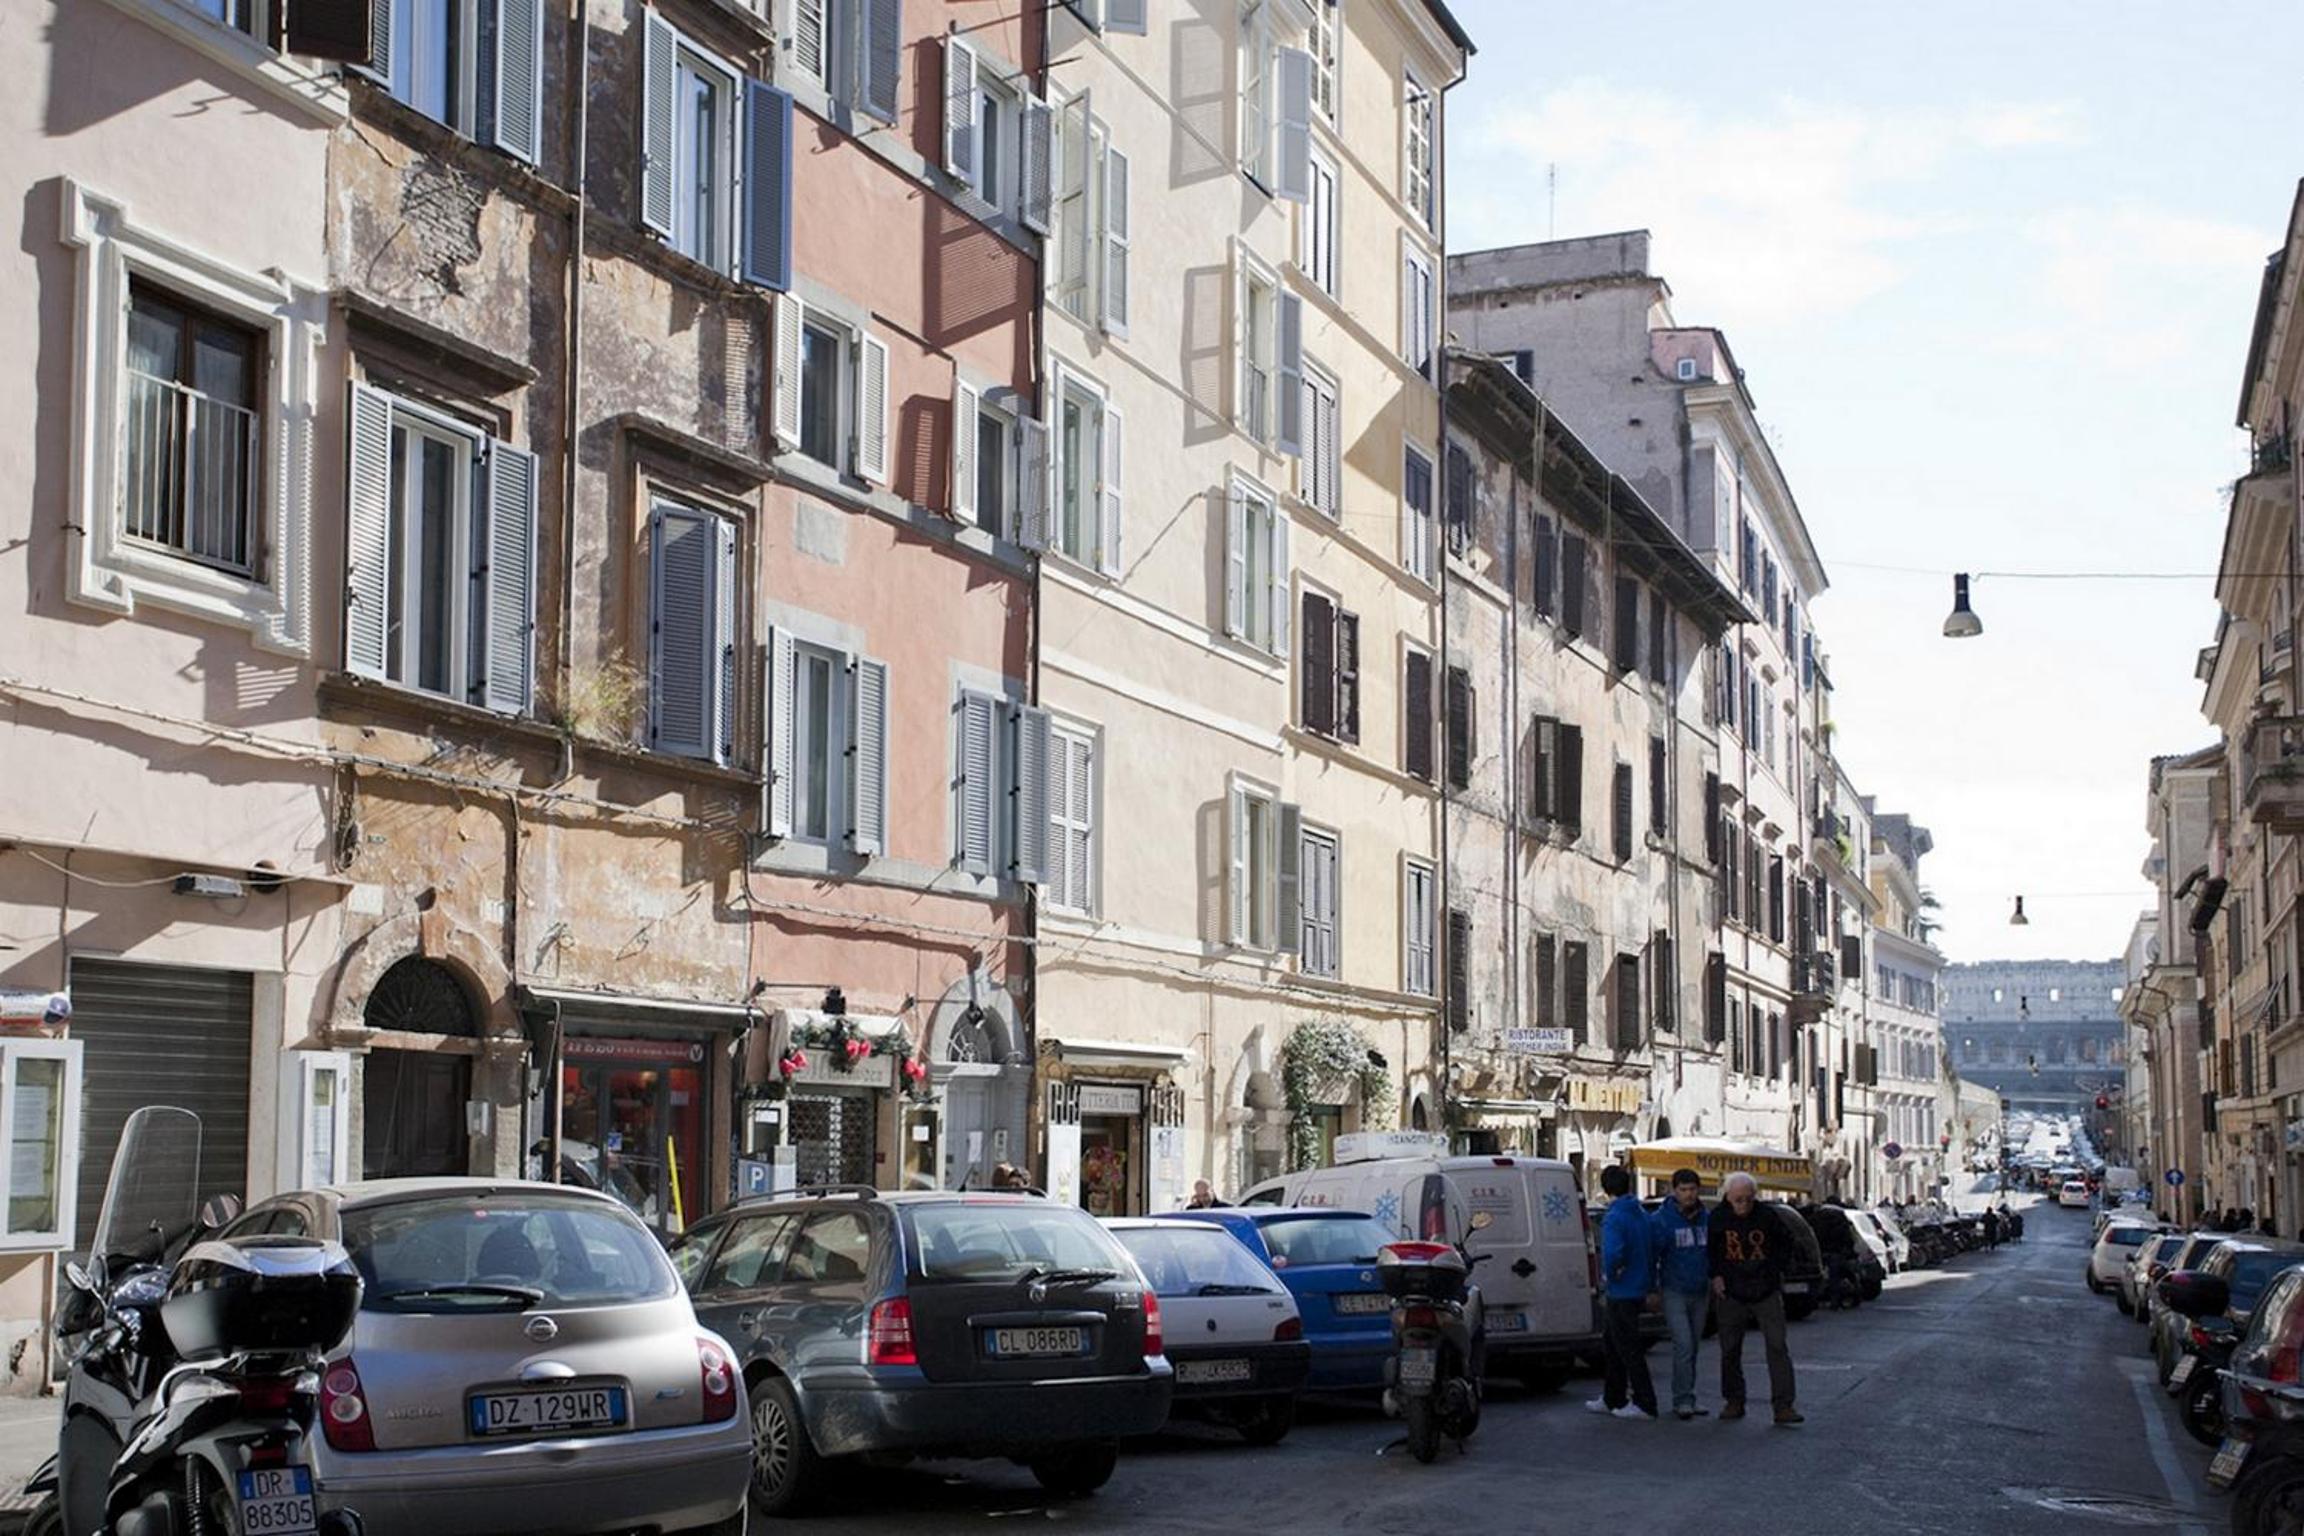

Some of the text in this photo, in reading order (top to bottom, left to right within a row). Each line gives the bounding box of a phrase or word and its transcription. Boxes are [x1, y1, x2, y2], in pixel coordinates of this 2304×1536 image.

[1508, 1028, 1567, 1041] RISTORANTE
[1696, 1154, 1761, 1172] MOTHER
[1767, 1157, 1810, 1174] INDIA
[751, 1167, 765, 1188] P
[999, 1330, 1020, 1351] CL
[490, 1400, 521, 1425] DZ
[535, 1393, 607, 1423] 129WR
[256, 1472, 282, 1496] DR
[246, 1499, 312, 1529] 88305
